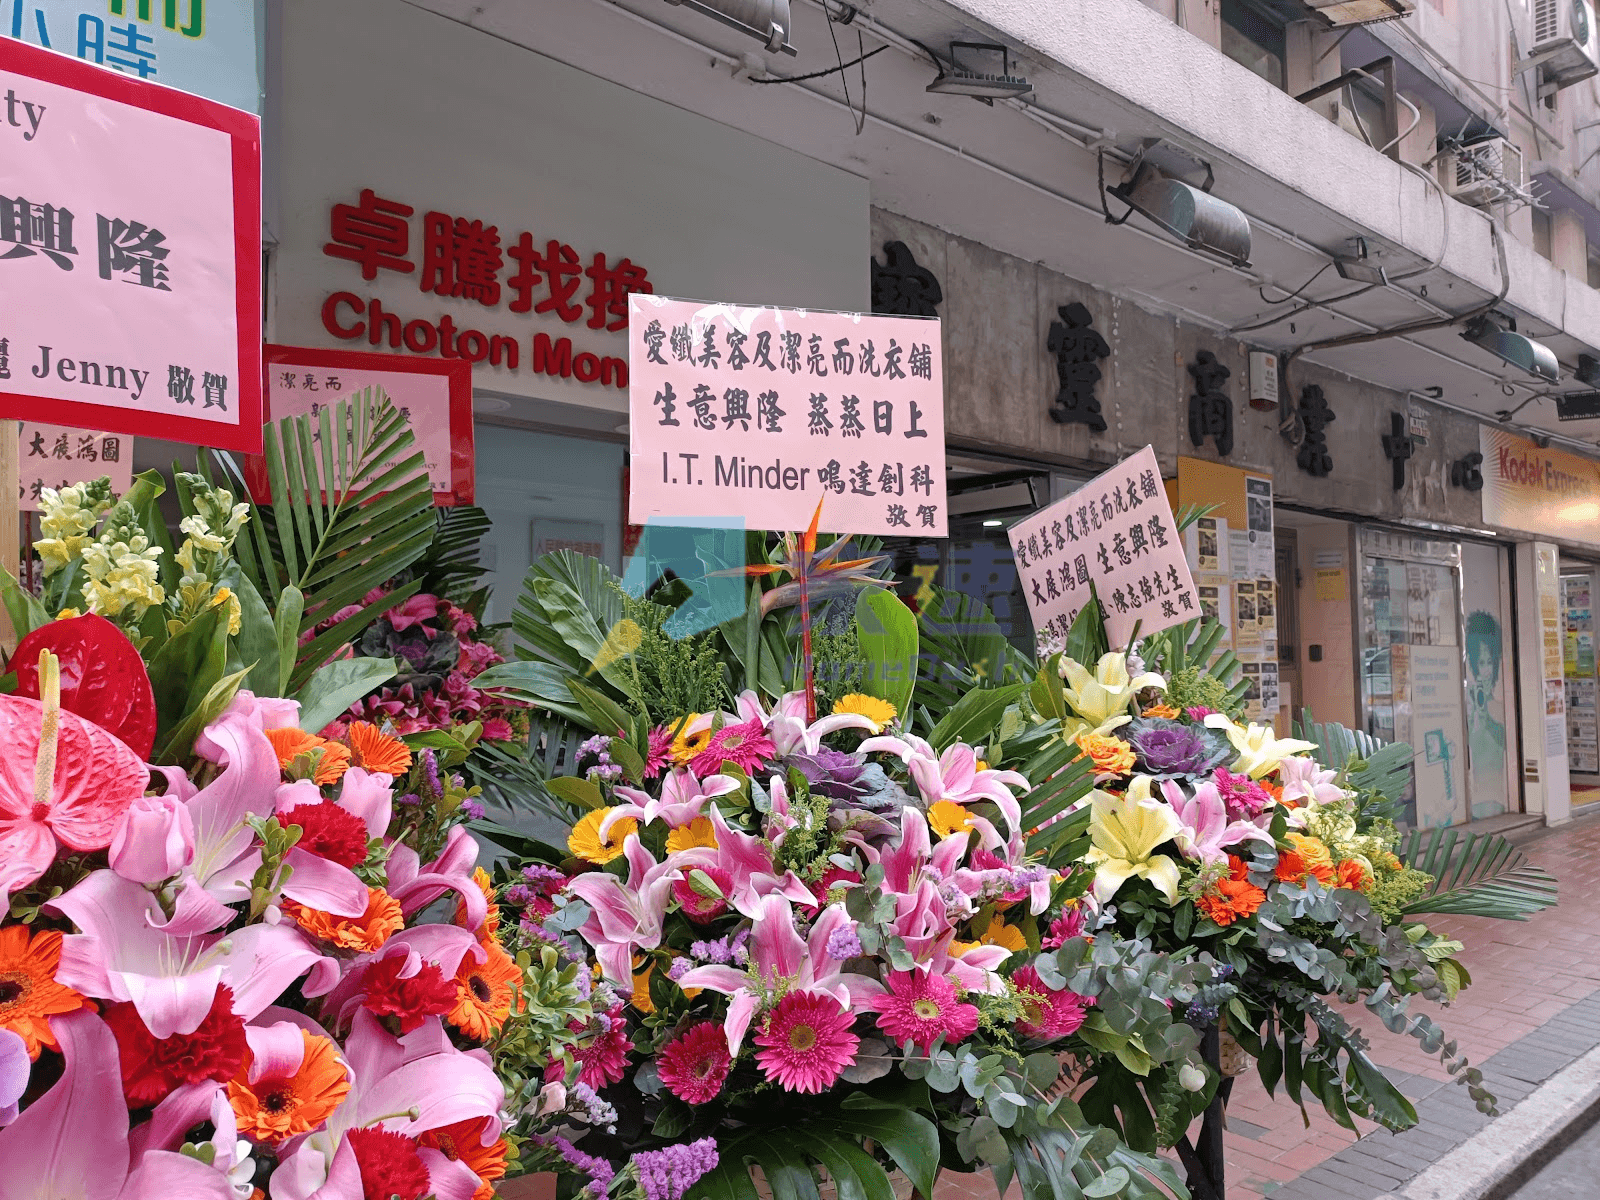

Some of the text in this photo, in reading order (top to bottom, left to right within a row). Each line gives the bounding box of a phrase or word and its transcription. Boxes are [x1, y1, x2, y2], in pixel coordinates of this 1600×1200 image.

[0, 88, 46, 141] ty
[0, 195, 172, 292] 興隆
[322, 188, 655, 333] 卓騰找換
[321, 291, 520, 370] Choton
[32, 345, 150, 401] Jenny
[167, 364, 228, 412] 敬賀
[280, 372, 342, 392] 潔亮而
[653, 382, 929, 439] 生意興隆 蒸蒸日上
[663, 452, 703, 487] I.T.
[714, 454, 810, 491] Minder
[1499, 446, 1543, 490] Kodak
[886, 504, 938, 529] 敬賀
[1031, 514, 1169, 607] 大展鴻圖 生意興隆
[1162, 591, 1194, 619] 敬賀
